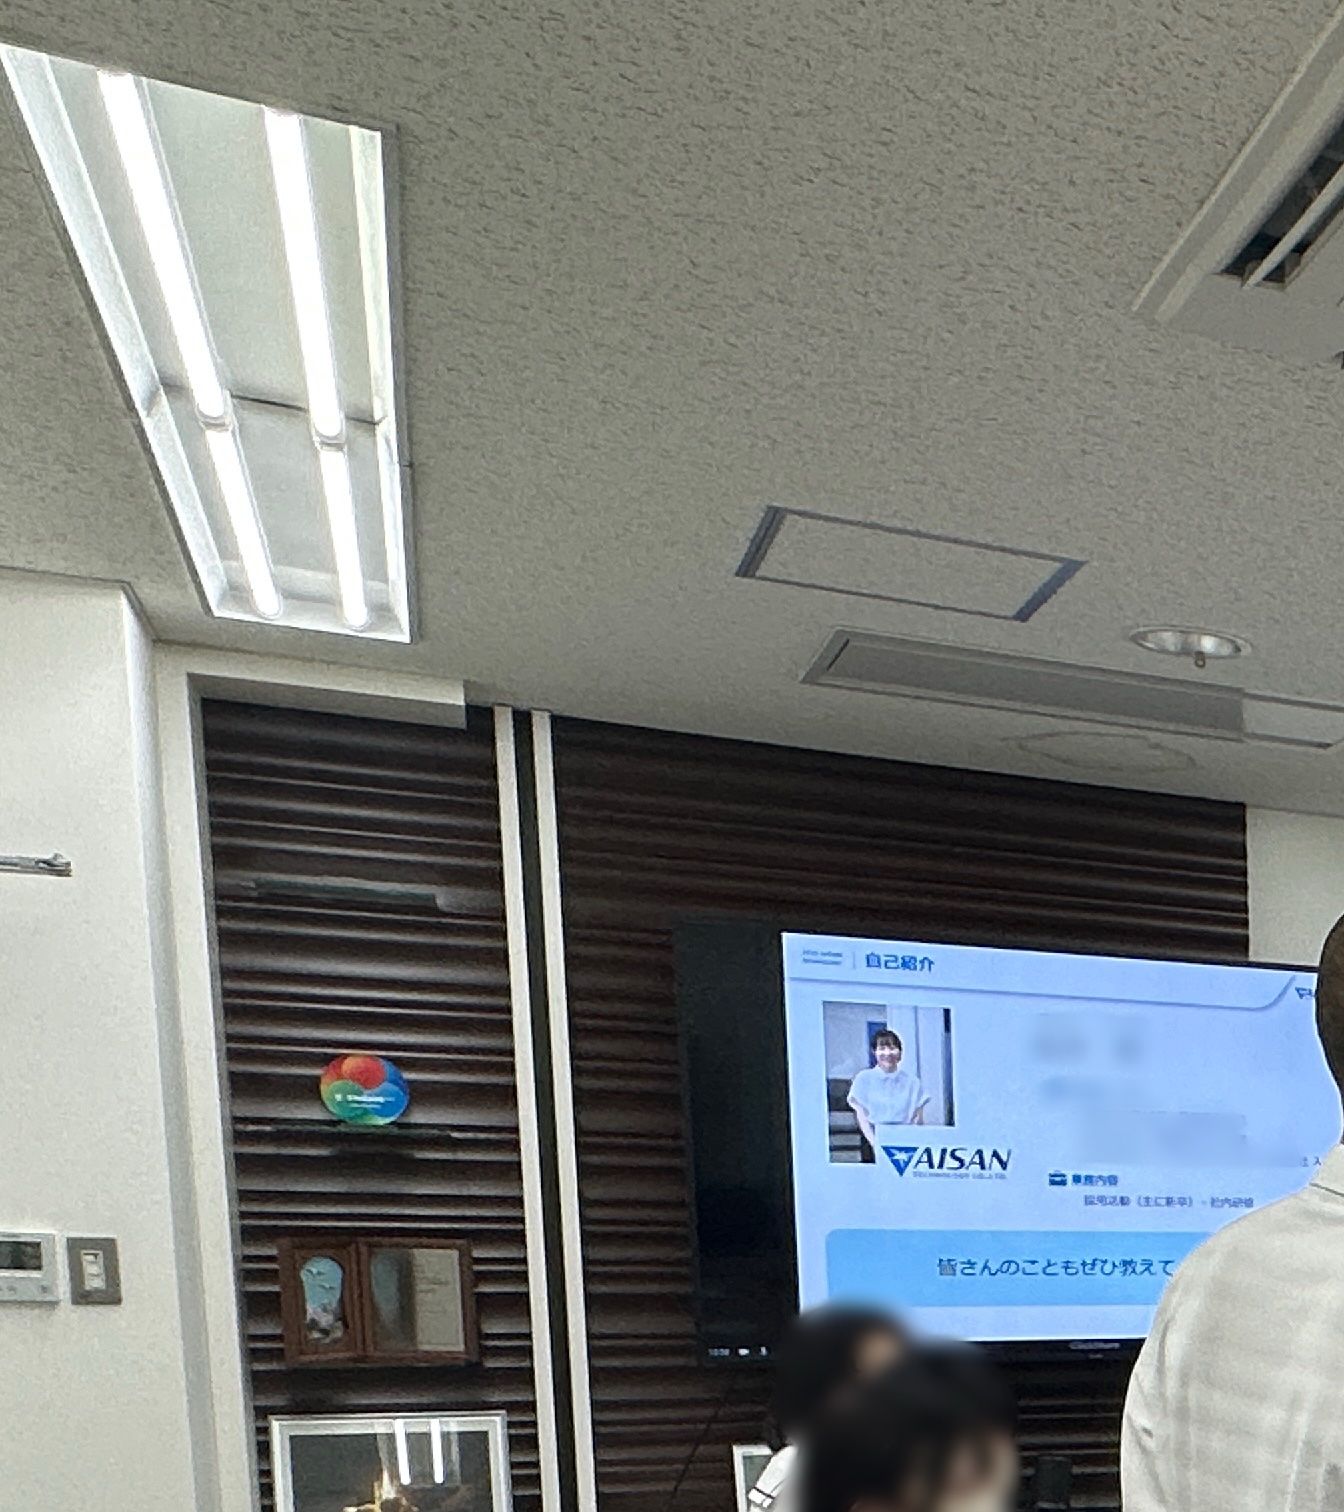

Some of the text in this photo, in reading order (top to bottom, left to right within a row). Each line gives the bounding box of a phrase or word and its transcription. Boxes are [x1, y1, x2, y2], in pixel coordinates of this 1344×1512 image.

[865, 952, 935, 972] 自己紹介
[912, 1146, 1012, 1171] AISAN
[937, 1257, 1176, 1277] 皆さんのこともぜひ教えて
